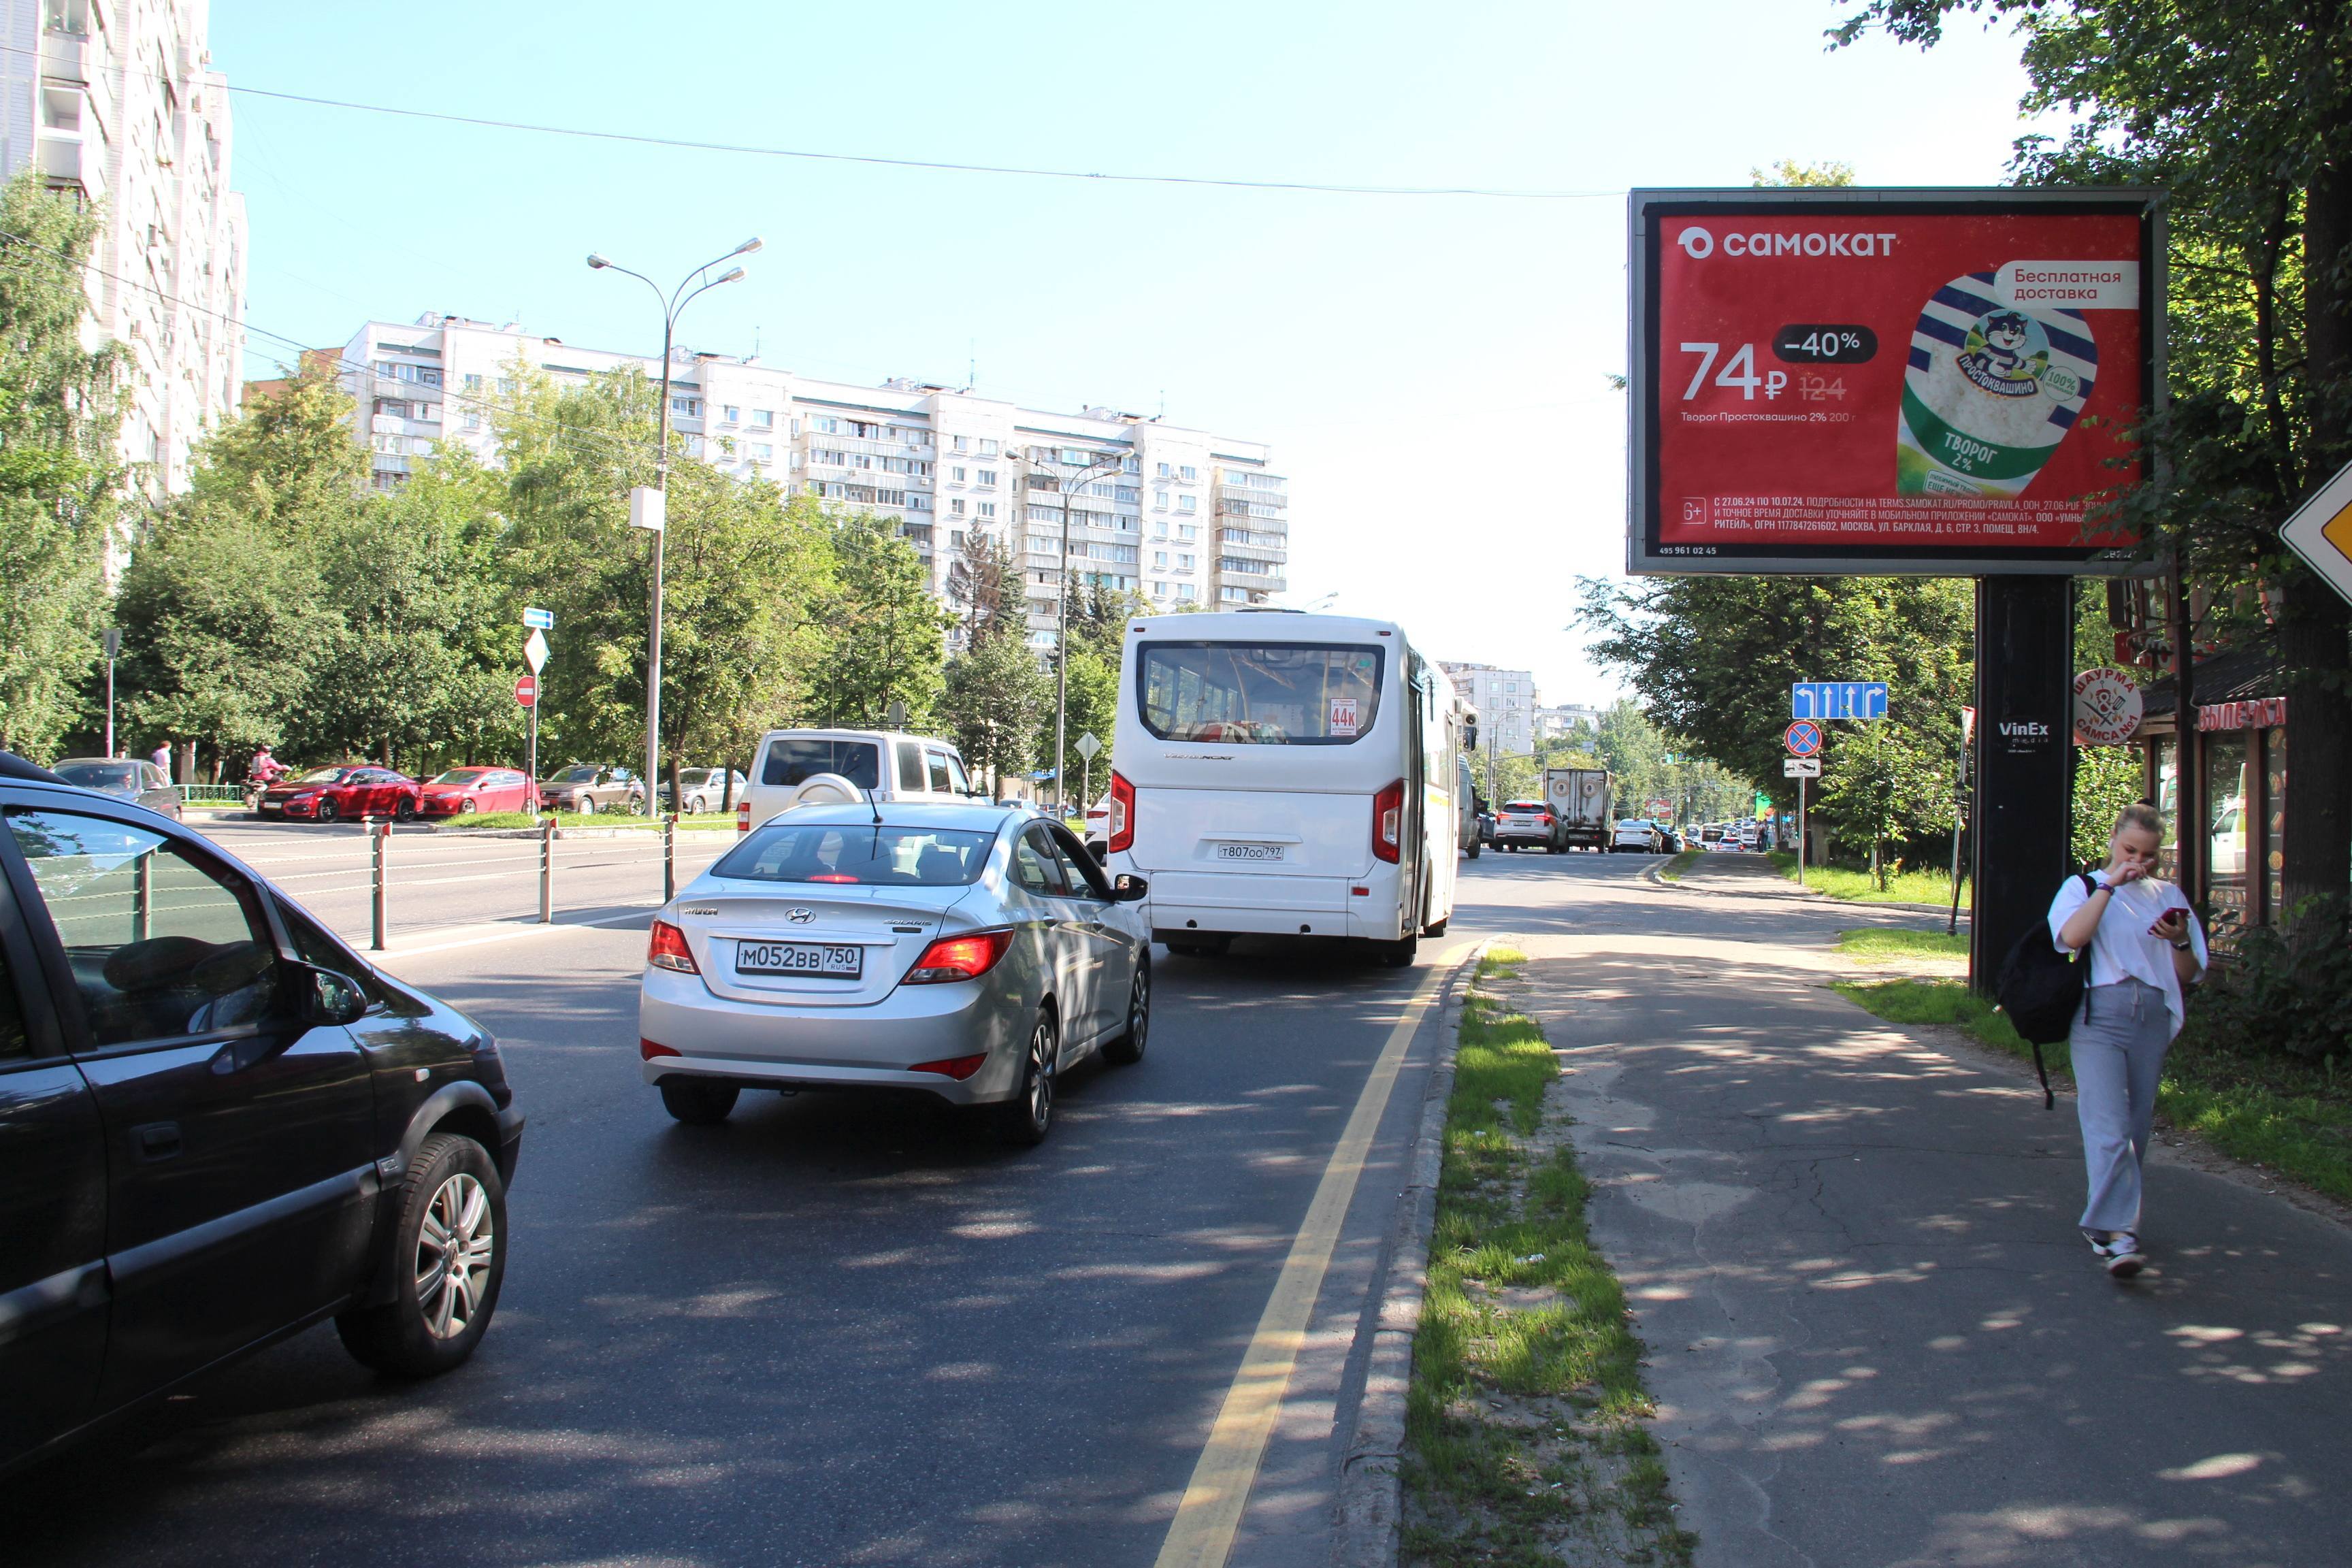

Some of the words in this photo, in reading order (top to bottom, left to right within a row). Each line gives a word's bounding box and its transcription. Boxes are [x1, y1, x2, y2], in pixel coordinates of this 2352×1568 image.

[1723, 233, 1897, 257] самокат
[2014, 269, 2121, 283] Бесплатная
[2014, 288, 2097, 301] доставка
[1959, 355, 2034, 394] ПРОСТОКВАШИНО
[2048, 372, 2076, 391] 100%
[1799, 376, 1847, 401] 124
[1681, 412, 1717, 422] Творог
[1720, 412, 1807, 423] Простоквашино
[1809, 412, 1827, 421] 2%
[1829, 412, 1849, 422] 200
[1944, 432, 1998, 464] ТВОРОГ
[1951, 453, 1972, 471] 2%
[1684, 502, 1701, 521] 6+
[1714, 497, 1720, 506] С
[1722, 497, 1754, 506] 27.06.24
[1757, 497, 1769, 506] ПО
[1771, 497, 1805, 506] 10.07.24.
[1807, 497, 1863, 508] ПОДРОБНОСТИ
[1866, 498, 1877, 508] НА
[1715, 508, 1720, 517] И
[1722, 508, 1752, 517] ТОЧНОЕ
[1754, 508, 1781, 517] ВРЕМЯ
[1783, 508, 1823, 519] ДОСТАВКИ
[1826, 508, 1869, 519] УТОЧНЯЙТЕ
[1871, 510, 1876, 519] В
[1879, 510, 1929, 520] МОБИЛЬНОМ
[1931, 511, 1985, 521] ПРИЛОЖЕНИИ
[2036, 512, 2053, 522] ООО
[2055, 512, 2087, 523] «УМНЫ
[1715, 518, 1752, 529] РИТЕЙЛ»,
[1754, 520, 1775, 529] ОГРН
[1778, 521, 1838, 532] 1177847261602,
[1840, 522, 1876, 532] МОСКВА,
[1878, 523, 1891, 532] УЛ.
[1893, 523, 1933, 534] БАРКЛАЯ,
[1935, 523, 1944, 534] Д.
[1946, 523, 1954, 534] 6,
[1956, 524, 1972, 533] СТР.
[1974, 524, 1981, 534] 3,
[1983, 524, 2015, 535] ПОМЕЩ.
[2018, 525, 2040, 534] 8Н/4.
[2074, 669, 2135, 696] ШАУРМА
[1999, 722, 2049, 736] VinEx
[2076, 718, 2120, 741] САМСА
[2119, 715, 2138, 736] №1
[1264, 847, 1280, 855] 797
[743, 946, 820, 968] М052ВВ
[826, 947, 855, 964] 750
